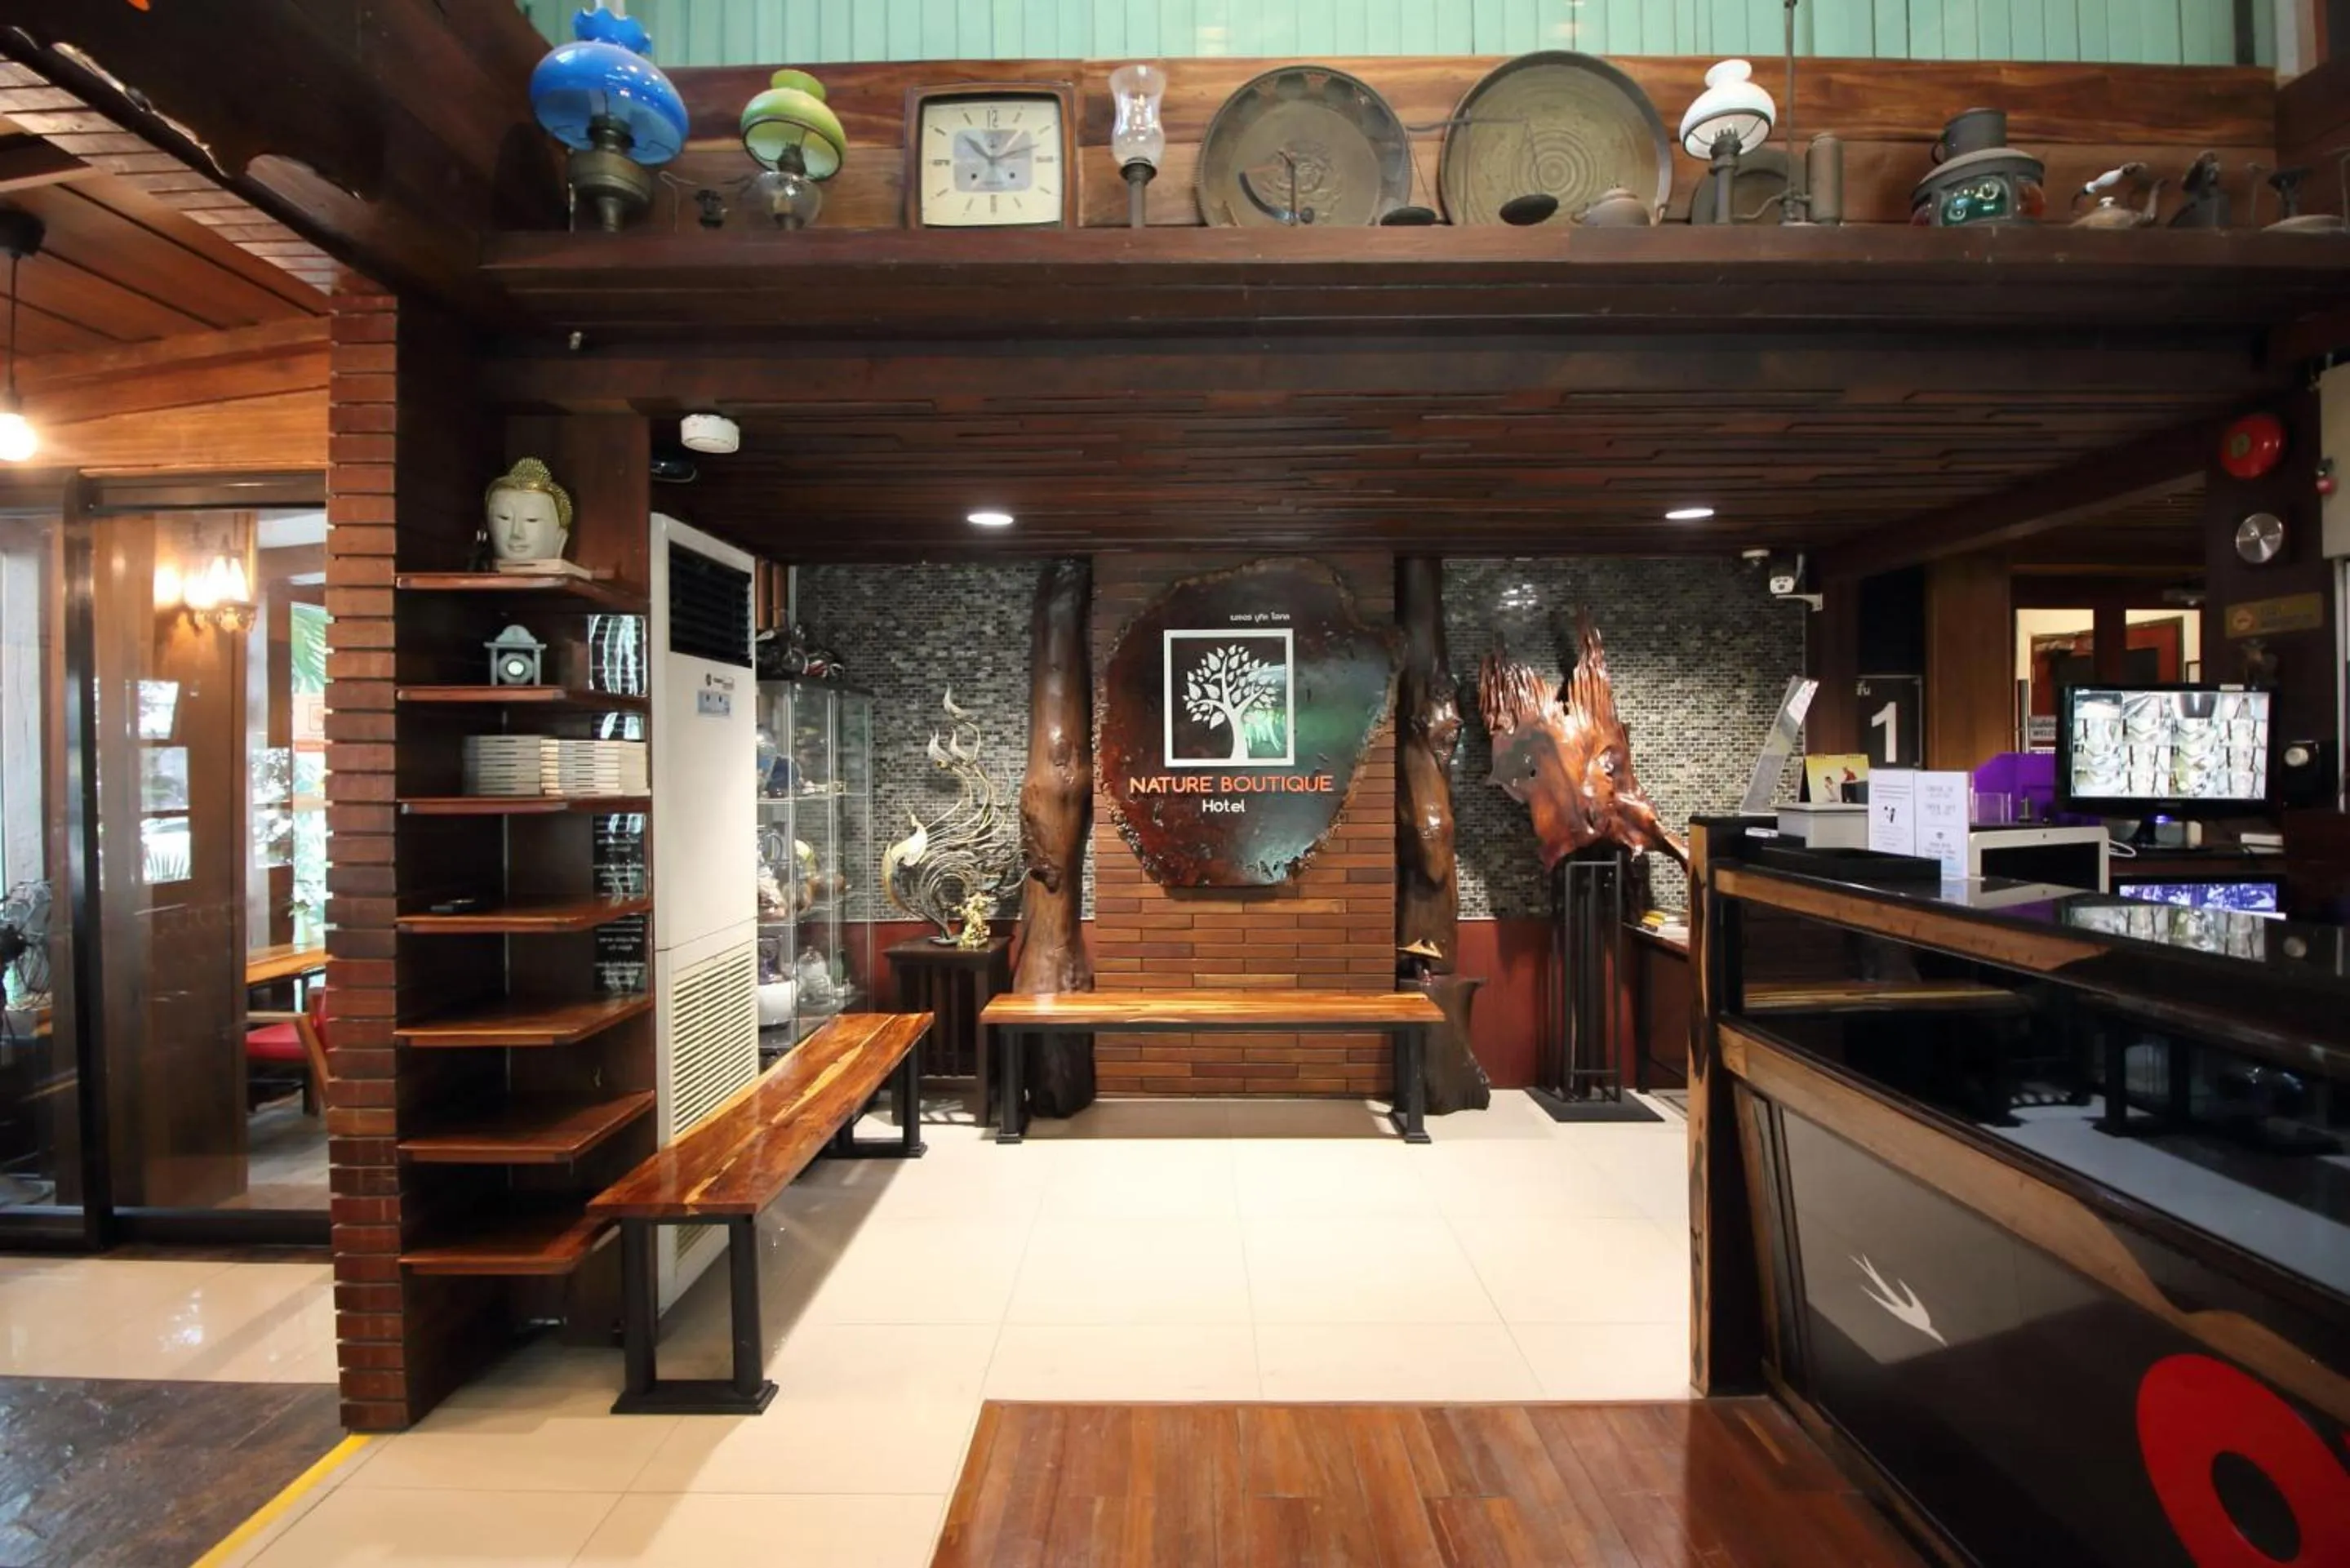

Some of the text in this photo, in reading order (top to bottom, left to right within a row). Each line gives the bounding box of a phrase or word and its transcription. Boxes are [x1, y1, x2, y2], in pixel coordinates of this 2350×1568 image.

[986, 109, 999, 128] 12
[1872, 701, 1897, 763] 1
[1130, 775, 1335, 793] NATURE BOUTIQUE
[1202, 798, 1246, 813] Hotel
